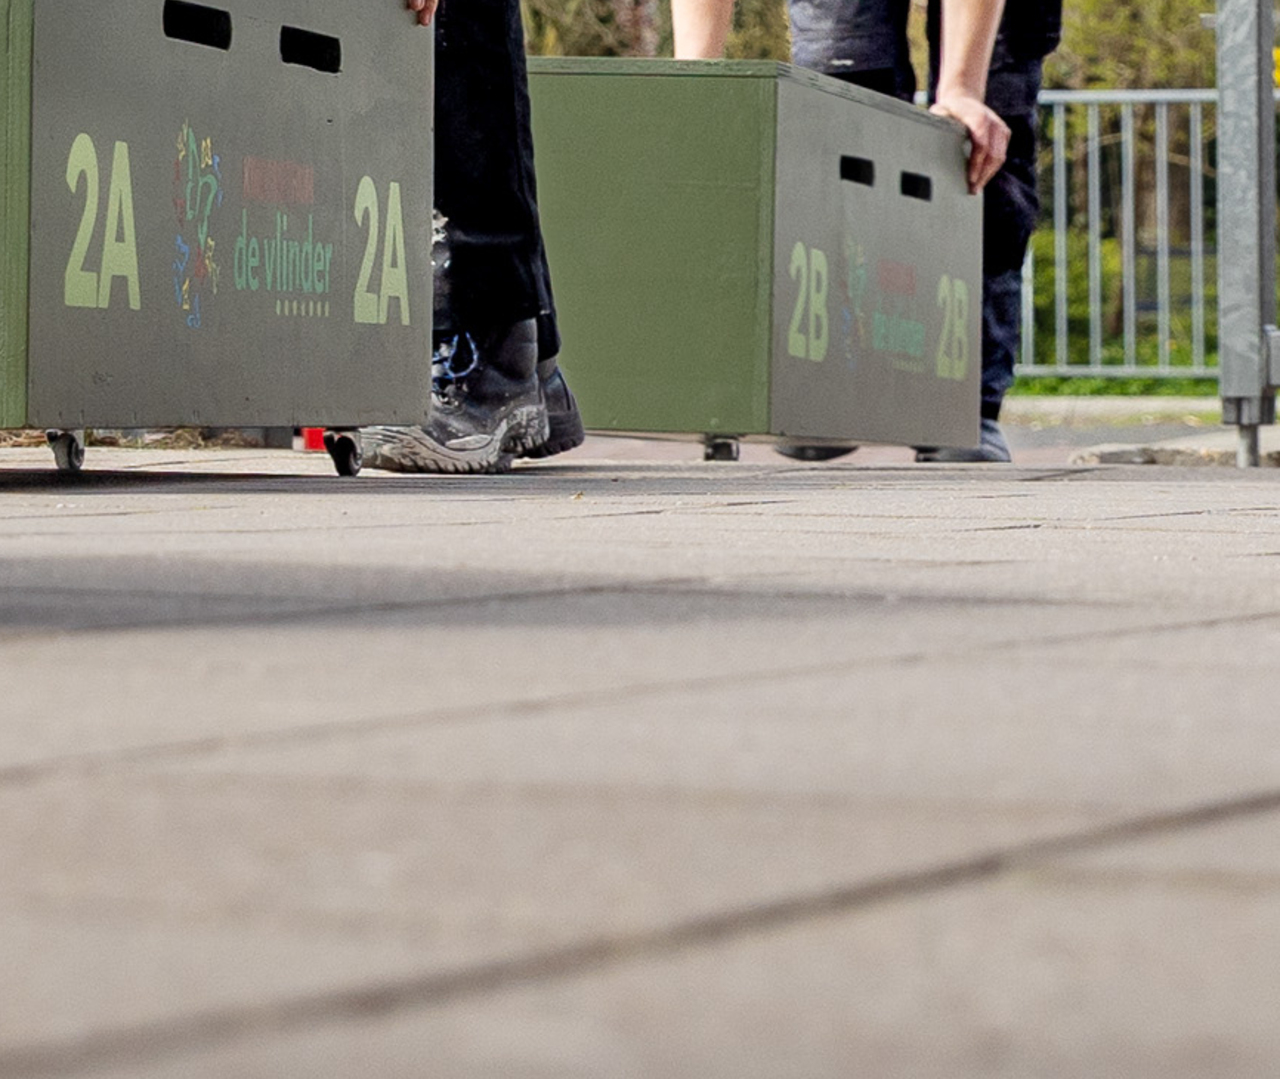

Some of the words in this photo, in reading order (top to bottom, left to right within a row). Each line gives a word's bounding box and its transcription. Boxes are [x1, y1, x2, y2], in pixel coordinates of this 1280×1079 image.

[64, 132, 140, 310] 2A
[234, 207, 259, 291] de
[263, 209, 333, 295] vlinder
[354, 175, 410, 326] 2A
[788, 241, 828, 362] 2B
[936, 273, 968, 381] 2B
